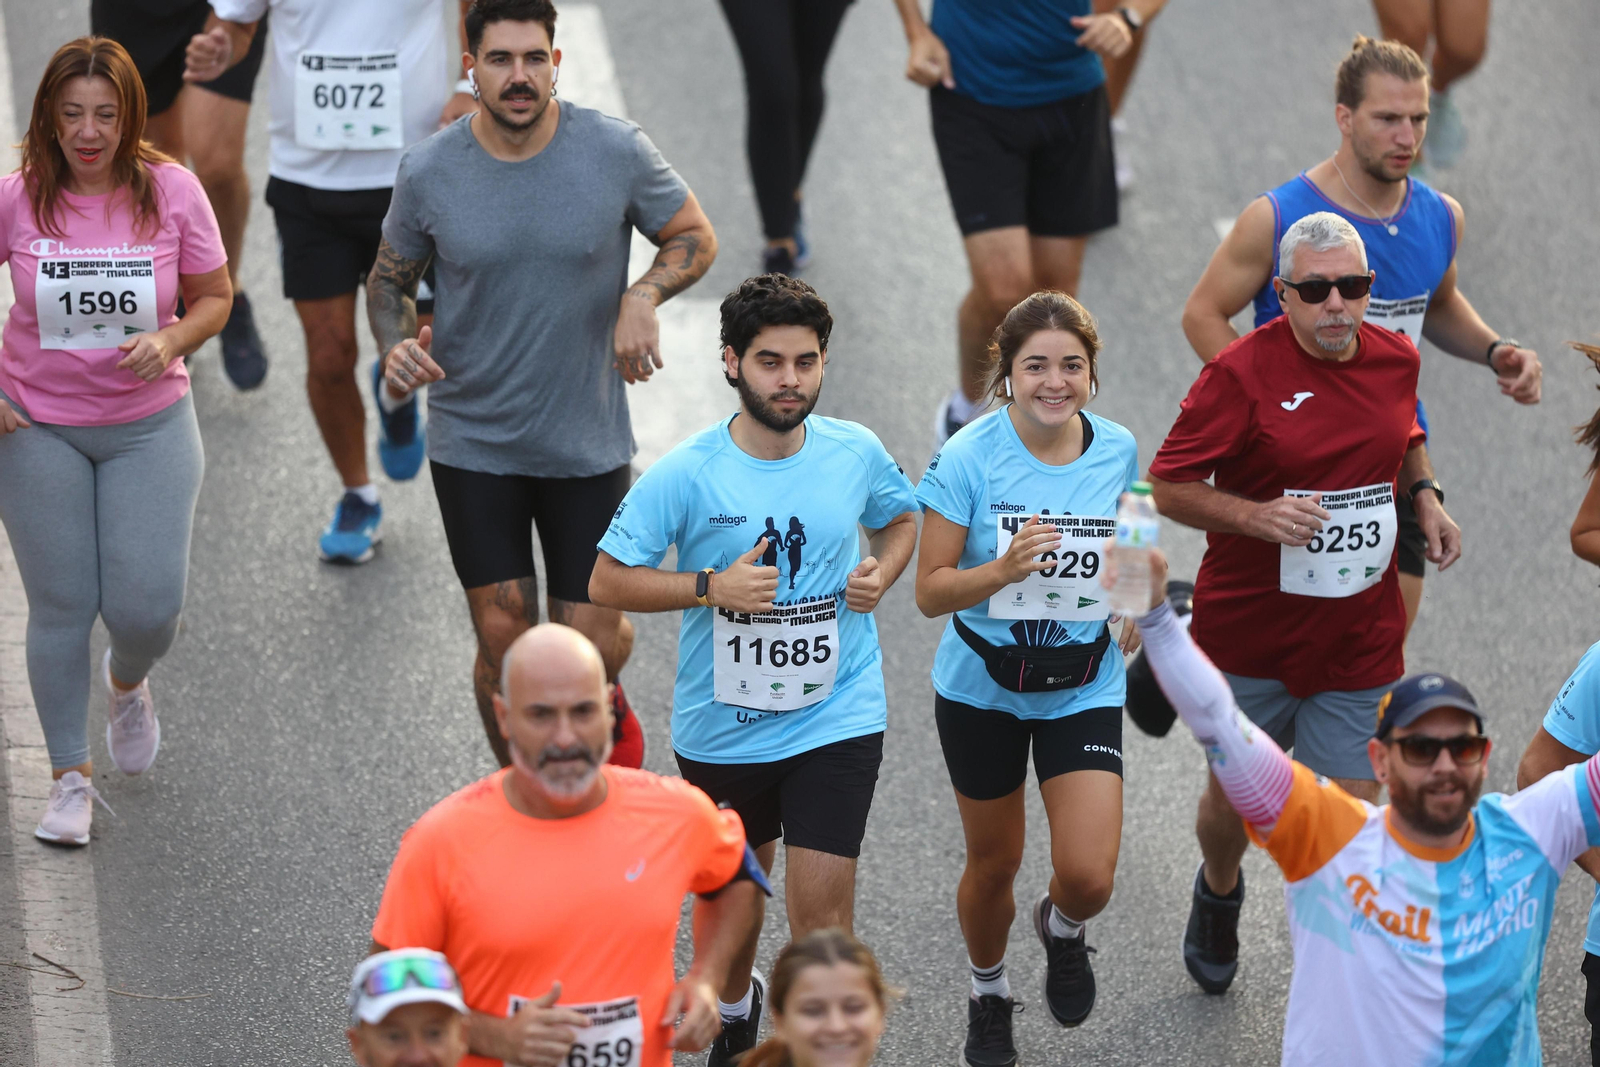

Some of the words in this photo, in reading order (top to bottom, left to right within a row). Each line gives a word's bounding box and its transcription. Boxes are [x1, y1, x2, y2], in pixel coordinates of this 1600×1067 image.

[314, 83, 385, 109] 6072
[29, 238, 157, 258] Champion
[41, 261, 70, 279] 43
[71, 261, 113, 269] CARRERA
[115, 260, 152, 268] URBANA
[58, 290, 138, 315] 1596
[1321, 491, 1362, 503] CARRERA
[1362, 485, 1392, 497] URBANA
[1321, 502, 1349, 511] CIUDAD
[1306, 520, 1381, 554] 6253
[1028, 551, 1100, 579] 029
[799, 600, 836, 615] URBANA
[752, 616, 782, 625] CIUDAD
[727, 634, 831, 668] 11685
[1345, 874, 1432, 943] Trail
